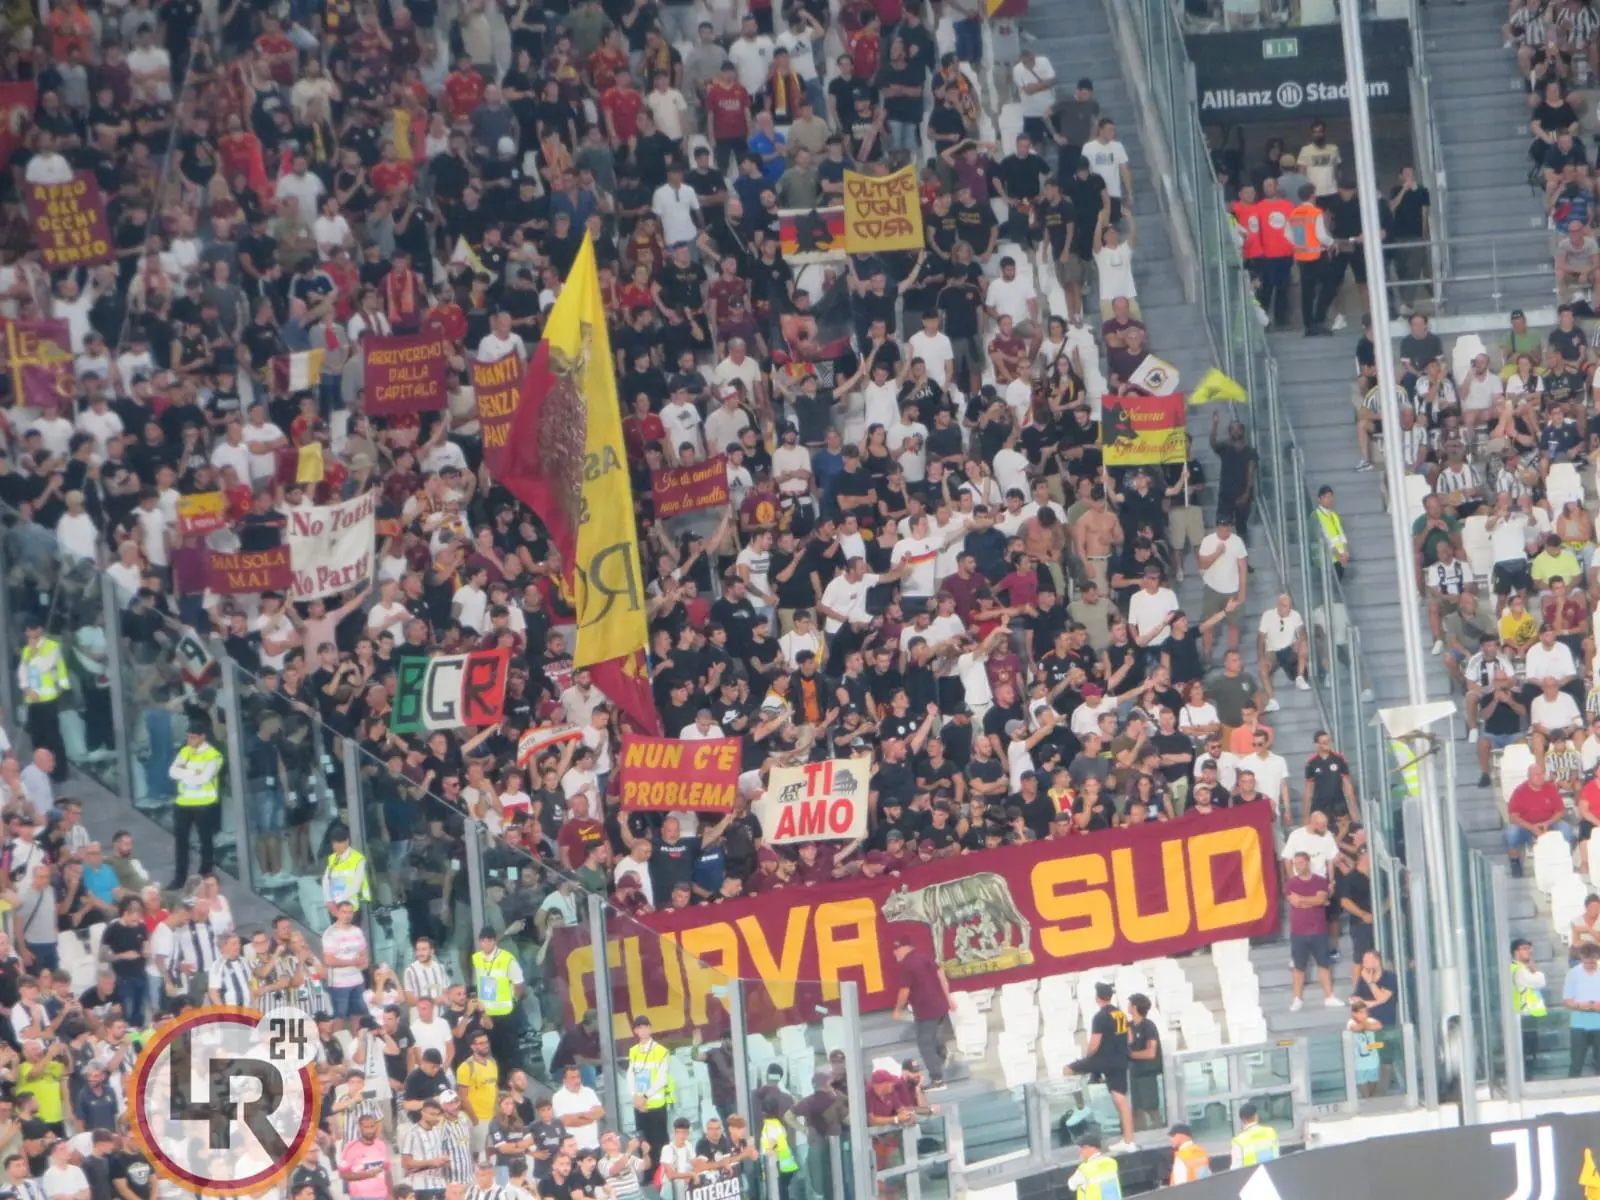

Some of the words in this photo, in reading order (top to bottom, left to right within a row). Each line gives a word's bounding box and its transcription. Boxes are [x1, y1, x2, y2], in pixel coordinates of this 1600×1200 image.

[1202, 89, 1272, 109] Allianz
[1306, 81, 1390, 101] Stadm
[847, 173, 915, 198] OLTRE
[856, 195, 907, 218] OGNI
[853, 218, 914, 238] COSA
[289, 511, 323, 537] No
[242, 551, 286, 569] SOLA
[228, 570, 270, 589] MAI
[396, 655, 500, 725] BGR
[624, 743, 683, 769] NUN
[804, 761, 834, 797] TI
[624, 780, 737, 809] PROBLEMA
[774, 798, 855, 840] AMO
[565, 896, 885, 1041] CURVA
[1030, 825, 1268, 958] SUD
